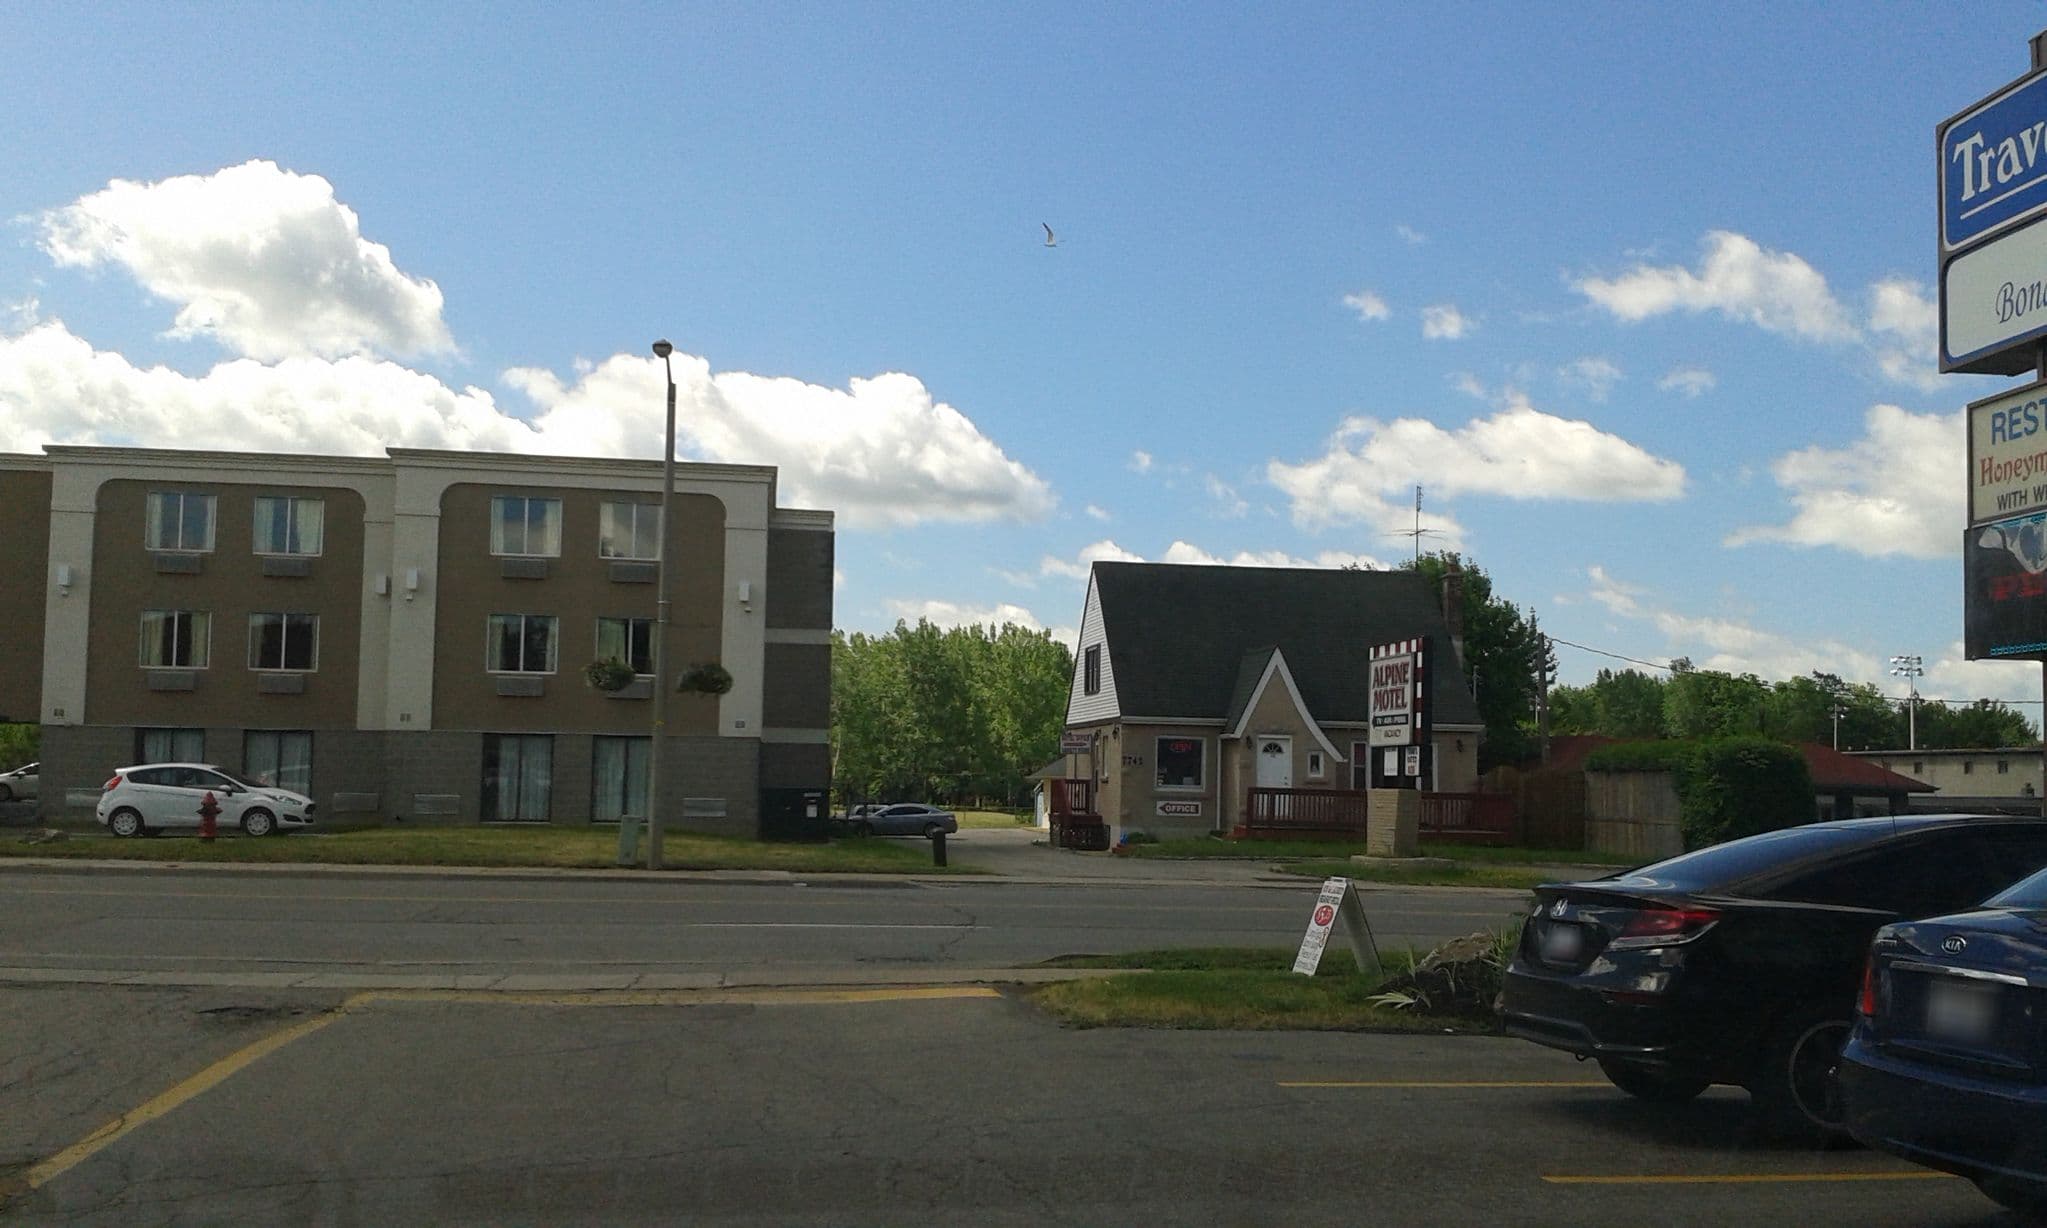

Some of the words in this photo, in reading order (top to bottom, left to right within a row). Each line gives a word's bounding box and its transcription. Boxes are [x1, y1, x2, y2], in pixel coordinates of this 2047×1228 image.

[1953, 120, 2047, 202] Trav
[1997, 490, 2028, 511] WITH
[2033, 482, 2047, 504] W
[1372, 662, 1409, 689] ALPINE
[1373, 687, 1408, 712] MOTEL
[1164, 804, 1197, 814] OFFICE
